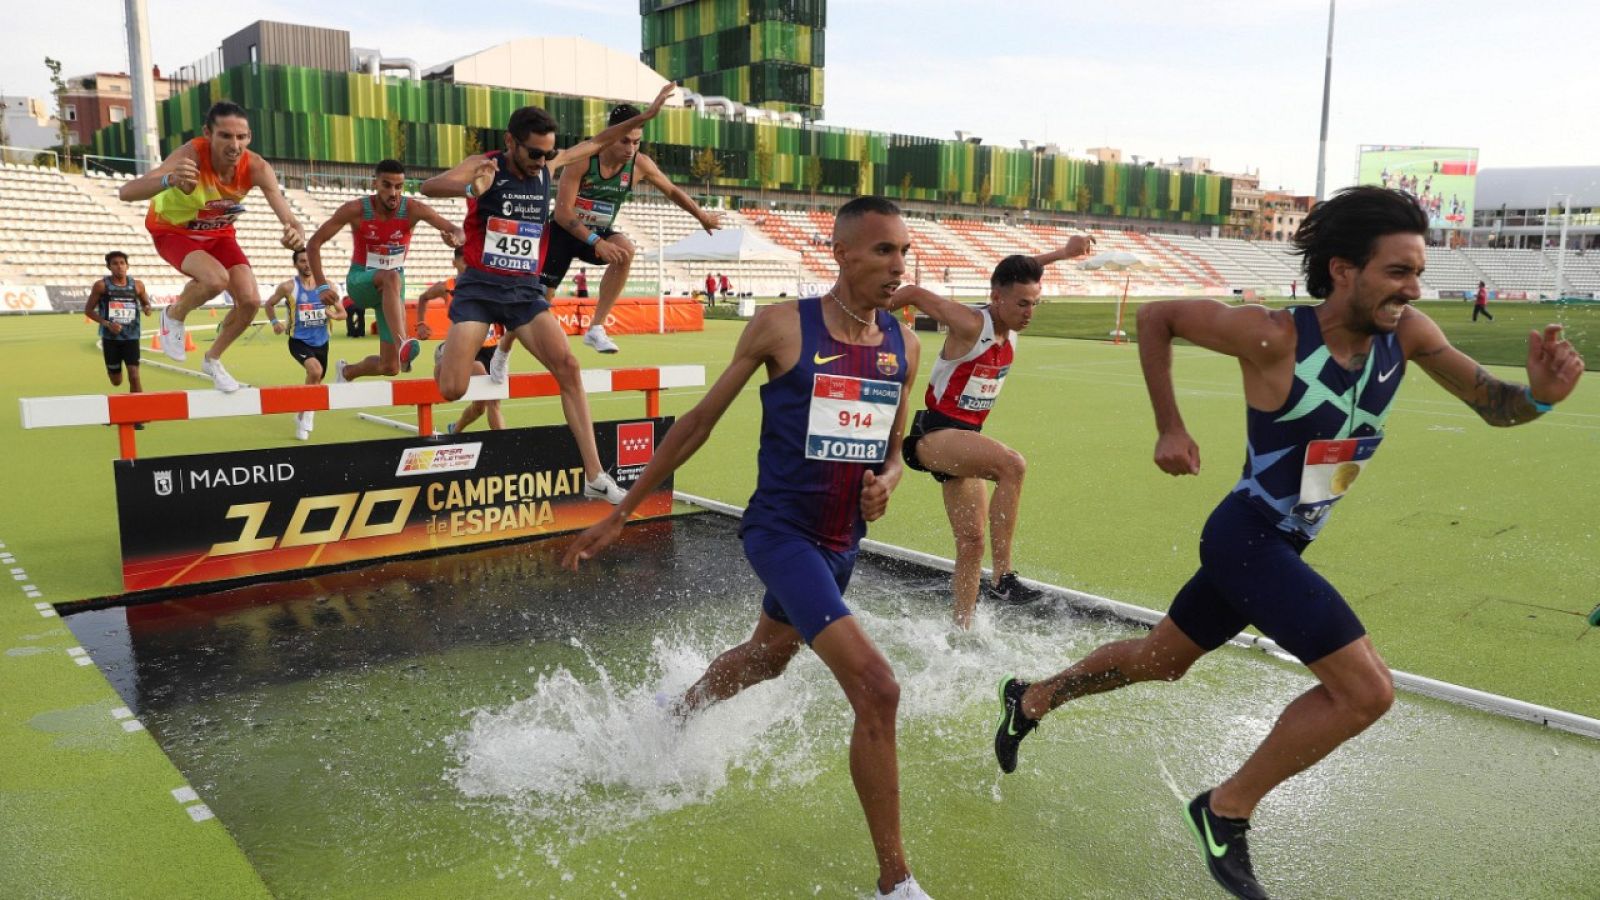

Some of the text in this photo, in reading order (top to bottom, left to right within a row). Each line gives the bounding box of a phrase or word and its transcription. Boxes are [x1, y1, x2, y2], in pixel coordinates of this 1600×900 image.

[495, 236, 532, 256] 459
[114, 308, 132, 317] 517
[304, 310, 323, 319] 516
[558, 314, 617, 328] MADD
[838, 410, 872, 428] 914
[190, 463, 295, 490] MADRID
[426, 467, 584, 512] CAMPEONAT
[208, 486, 421, 557] 100
[426, 498, 556, 538] de ESPAÑA
